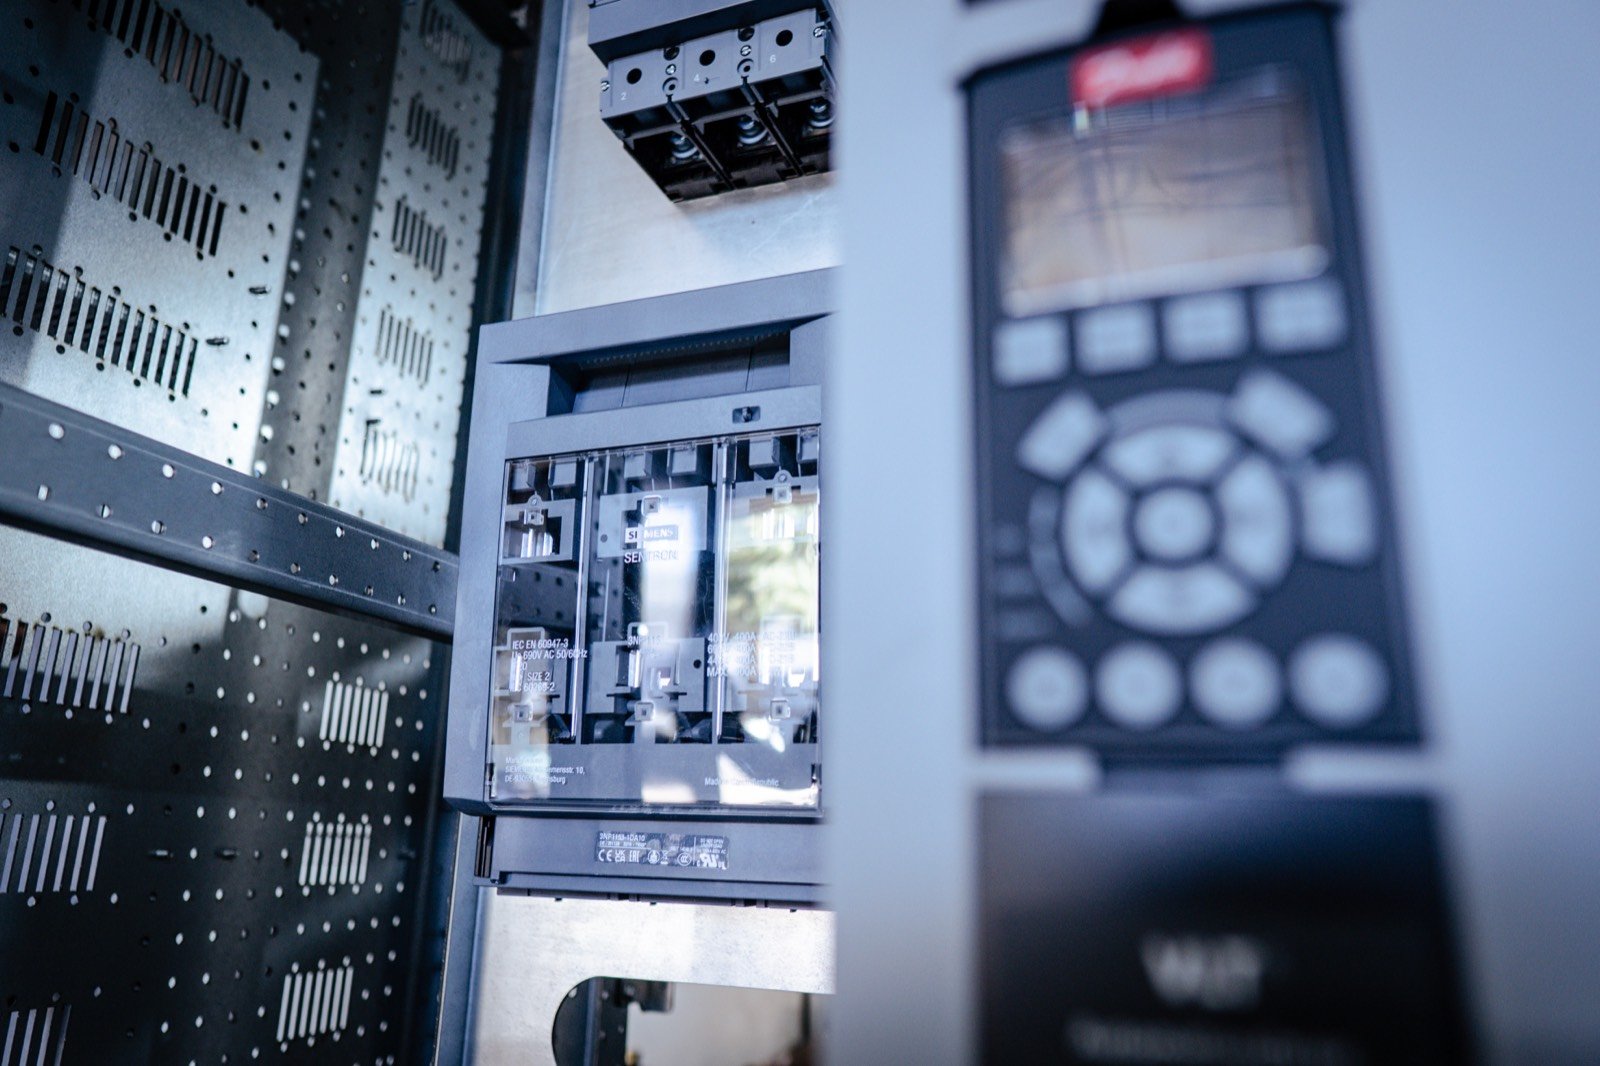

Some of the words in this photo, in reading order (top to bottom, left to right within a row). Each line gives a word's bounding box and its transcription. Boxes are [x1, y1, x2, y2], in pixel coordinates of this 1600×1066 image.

[769, 54, 777, 63] 6
[693, 73, 700, 82] 4
[621, 91, 628, 100] 2
[628, 528, 672, 540] SIMENS
[512, 639, 524, 650] IEC
[526, 639, 536, 649] EN
[537, 638, 569, 649] 60947-3
[523, 650, 542, 660] 690V
[543, 650, 554, 659] AC
[528, 671, 543, 681] SIZE
[545, 671, 550, 681] 2
